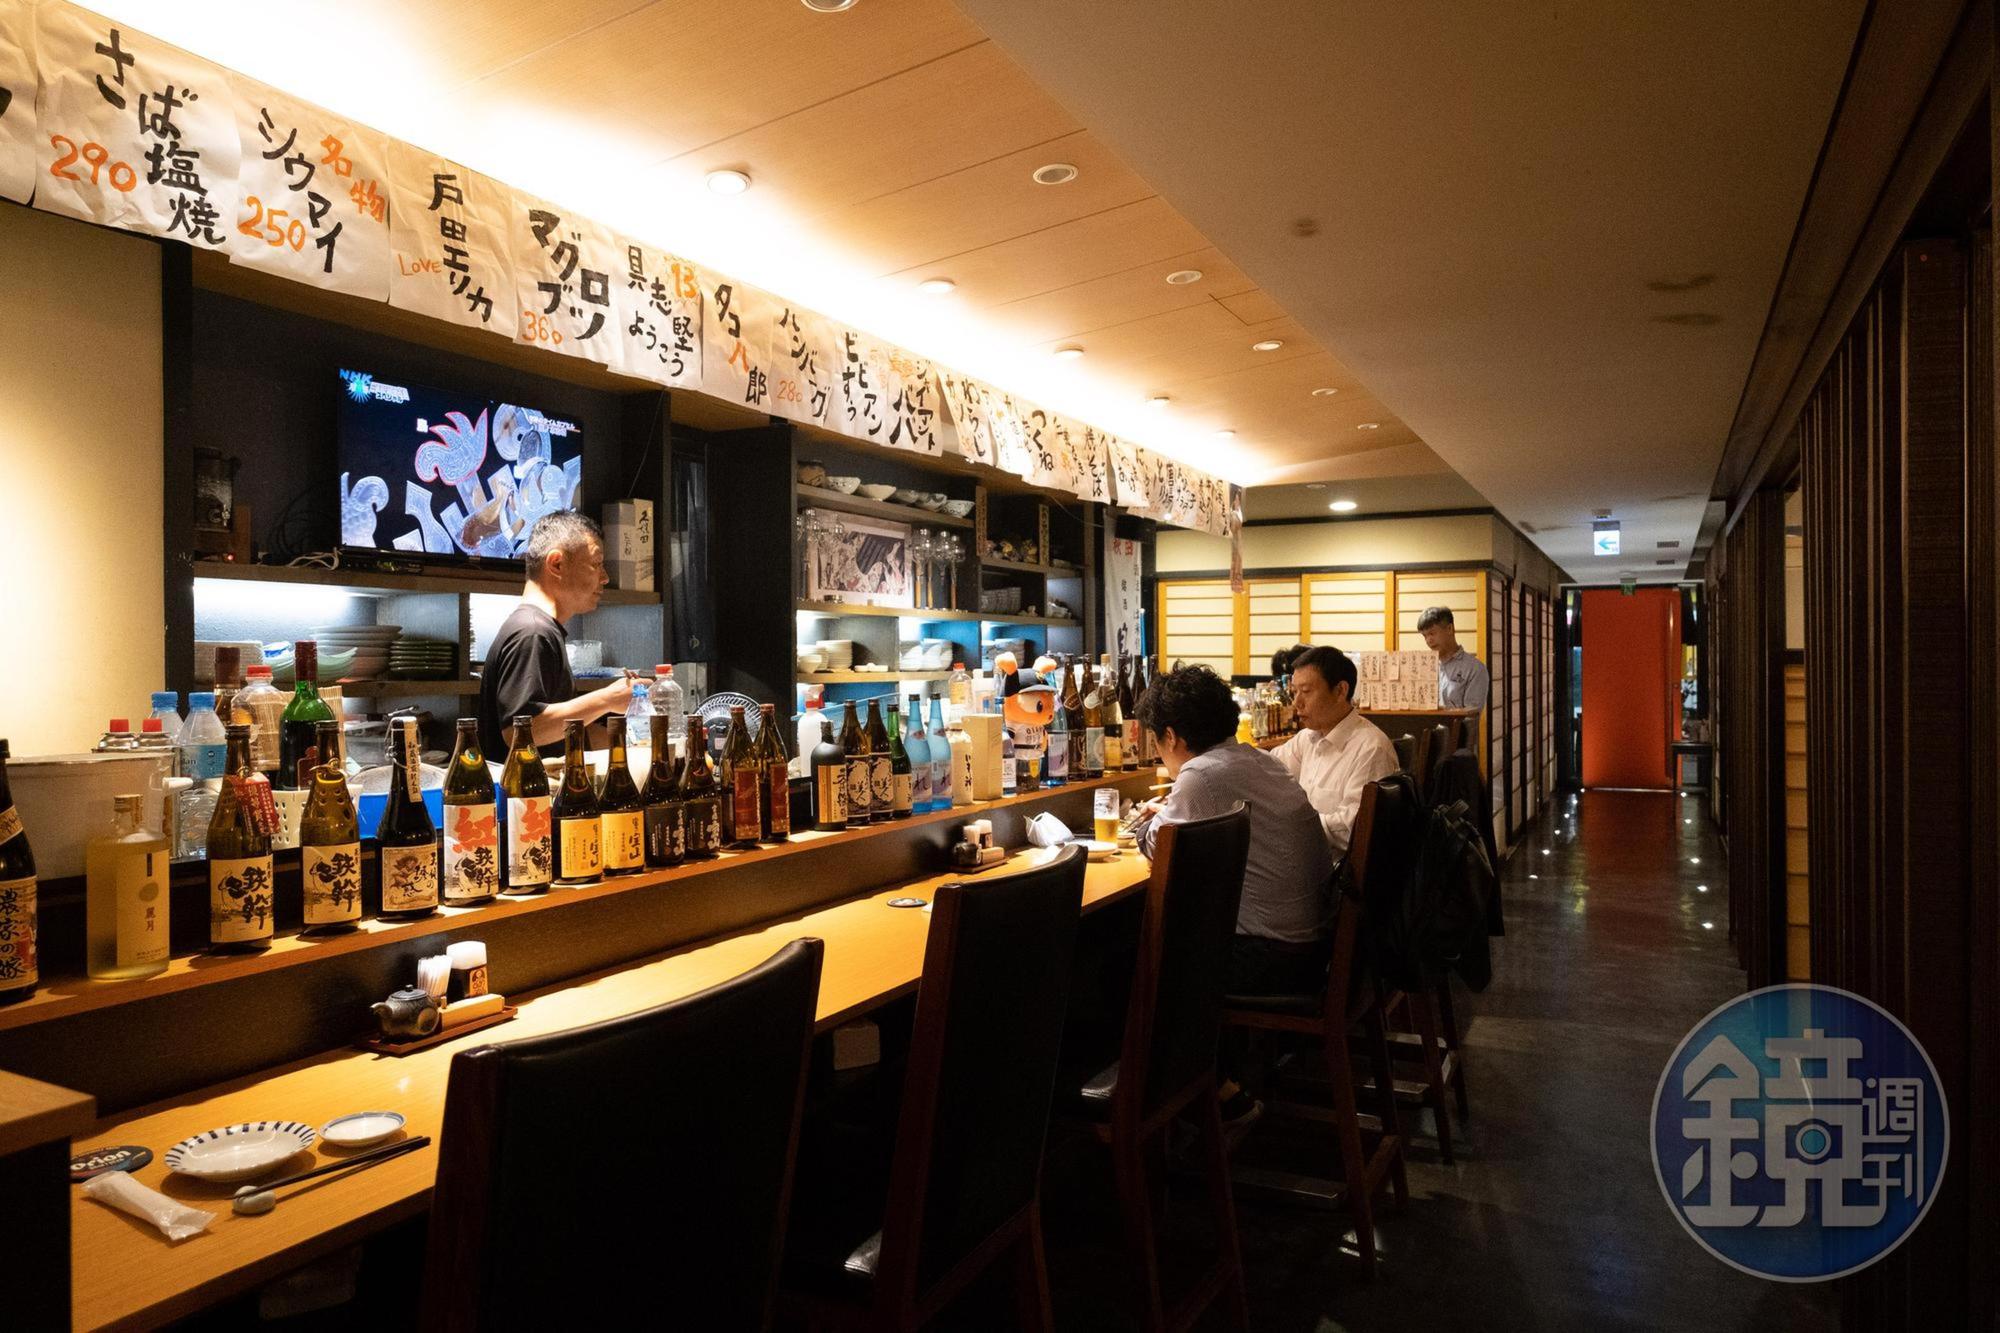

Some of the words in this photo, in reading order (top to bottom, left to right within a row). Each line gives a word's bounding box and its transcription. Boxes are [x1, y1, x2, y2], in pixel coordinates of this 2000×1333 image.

[50, 134, 137, 192] 290
[95, 29, 226, 245] さば塩焼
[257, 108, 342, 273] シウマイ
[320, 134, 385, 223] 名物
[237, 196, 306, 252] 250
[428, 174, 493, 322] 戸田エリカ
[670, 262, 699, 299] 13
[522, 311, 563, 345] 360
